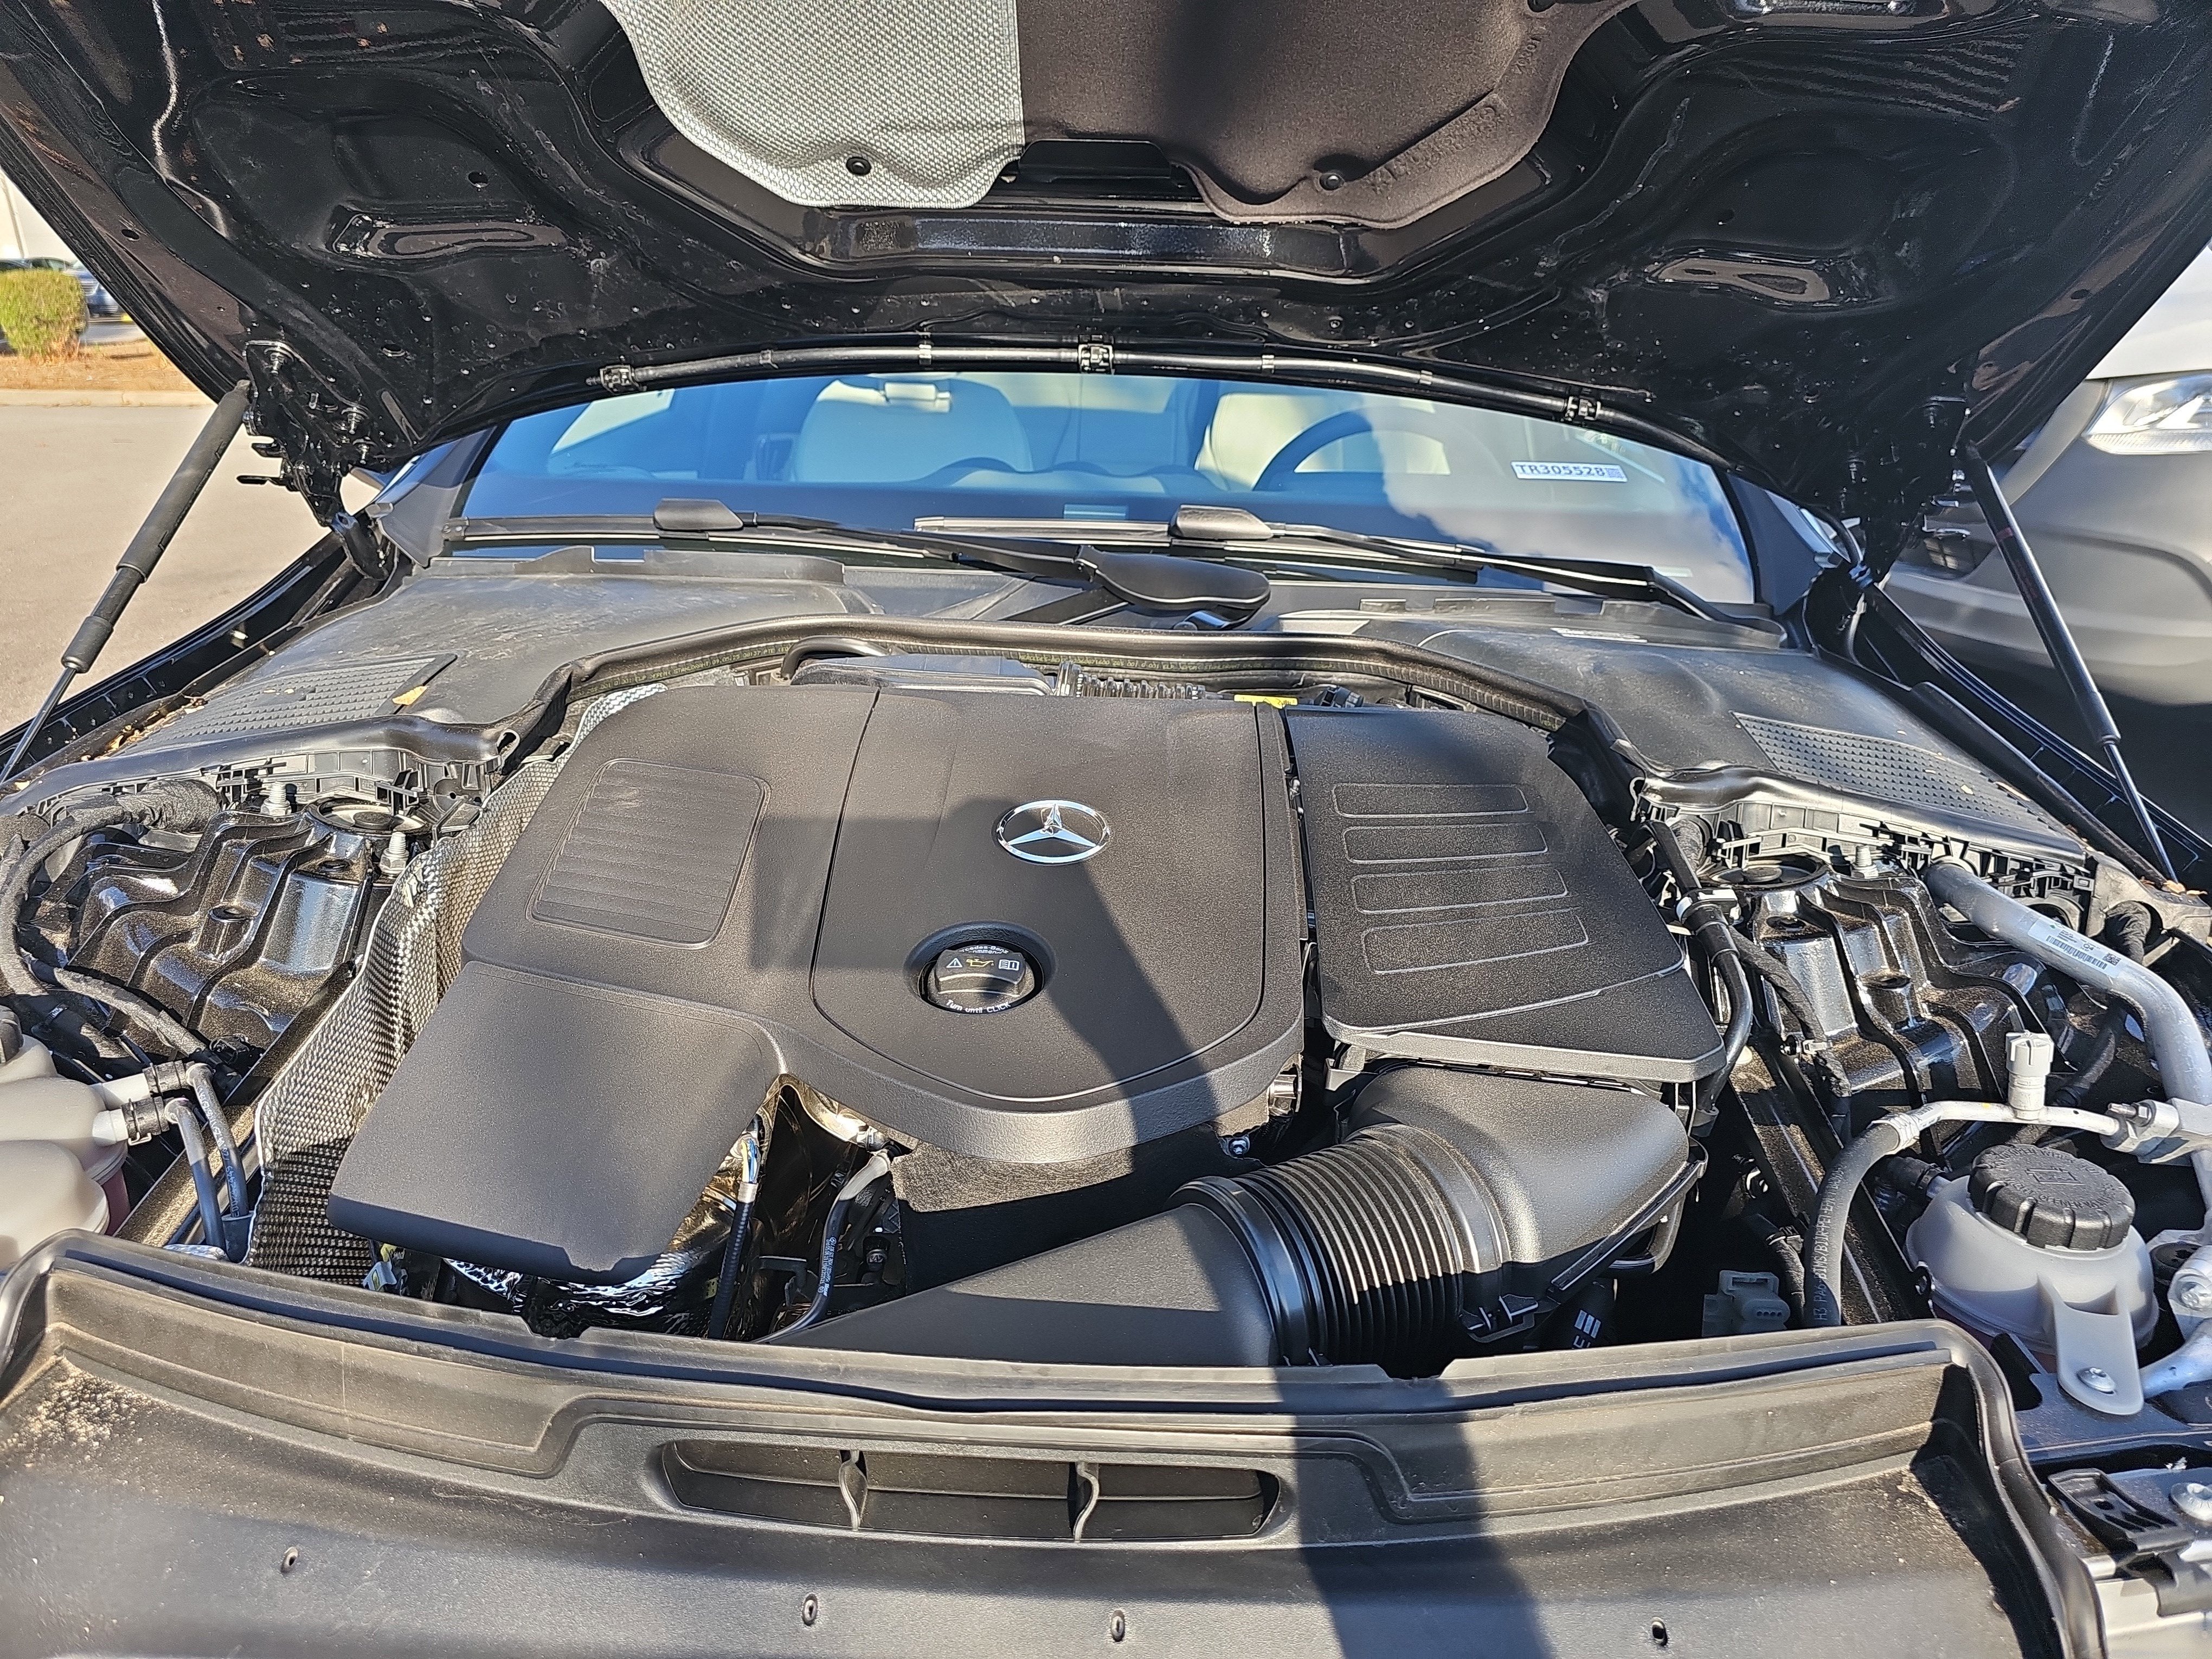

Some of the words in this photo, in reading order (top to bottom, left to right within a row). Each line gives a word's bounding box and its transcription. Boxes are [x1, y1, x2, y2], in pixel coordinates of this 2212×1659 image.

[1516, 464, 1605, 477] TR305528
[946, 999, 963, 1011] Turn
[986, 1001, 1011, 1013] CLICK
